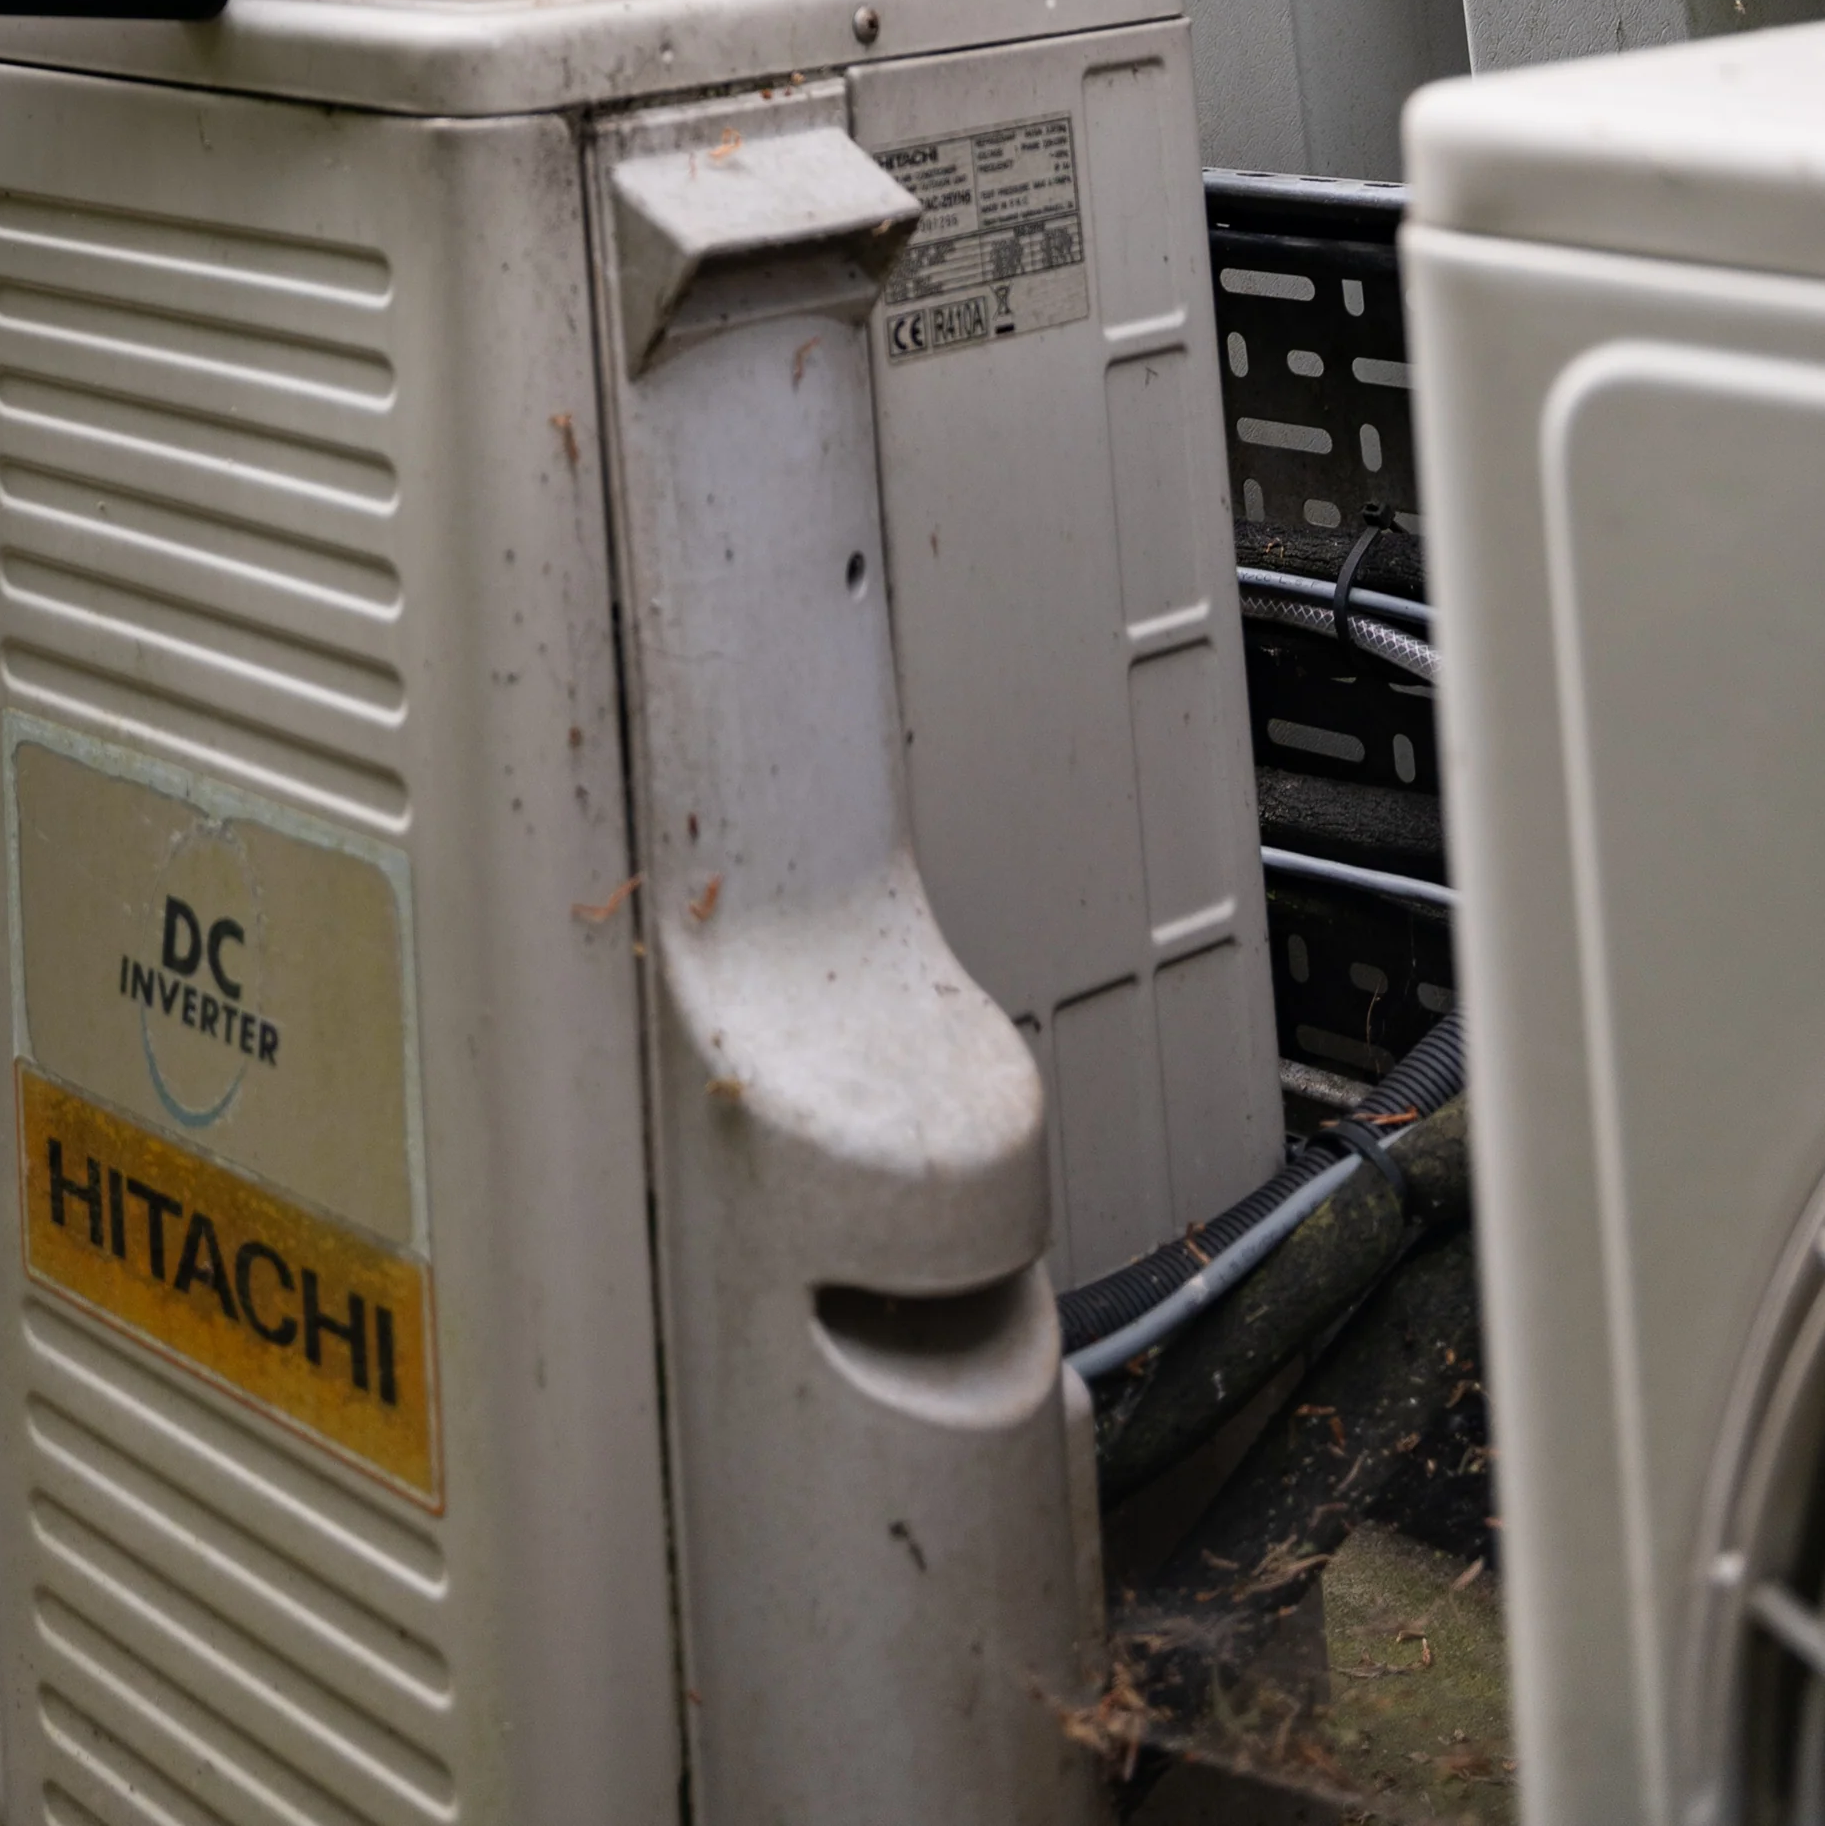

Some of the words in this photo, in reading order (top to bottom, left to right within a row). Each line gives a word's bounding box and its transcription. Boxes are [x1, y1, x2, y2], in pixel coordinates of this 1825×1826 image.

[934, 299, 985, 344] R410A
[163, 894, 247, 1002] DC
[119, 954, 280, 1069] INVERTER
[47, 1135, 399, 1408] HITACHI
